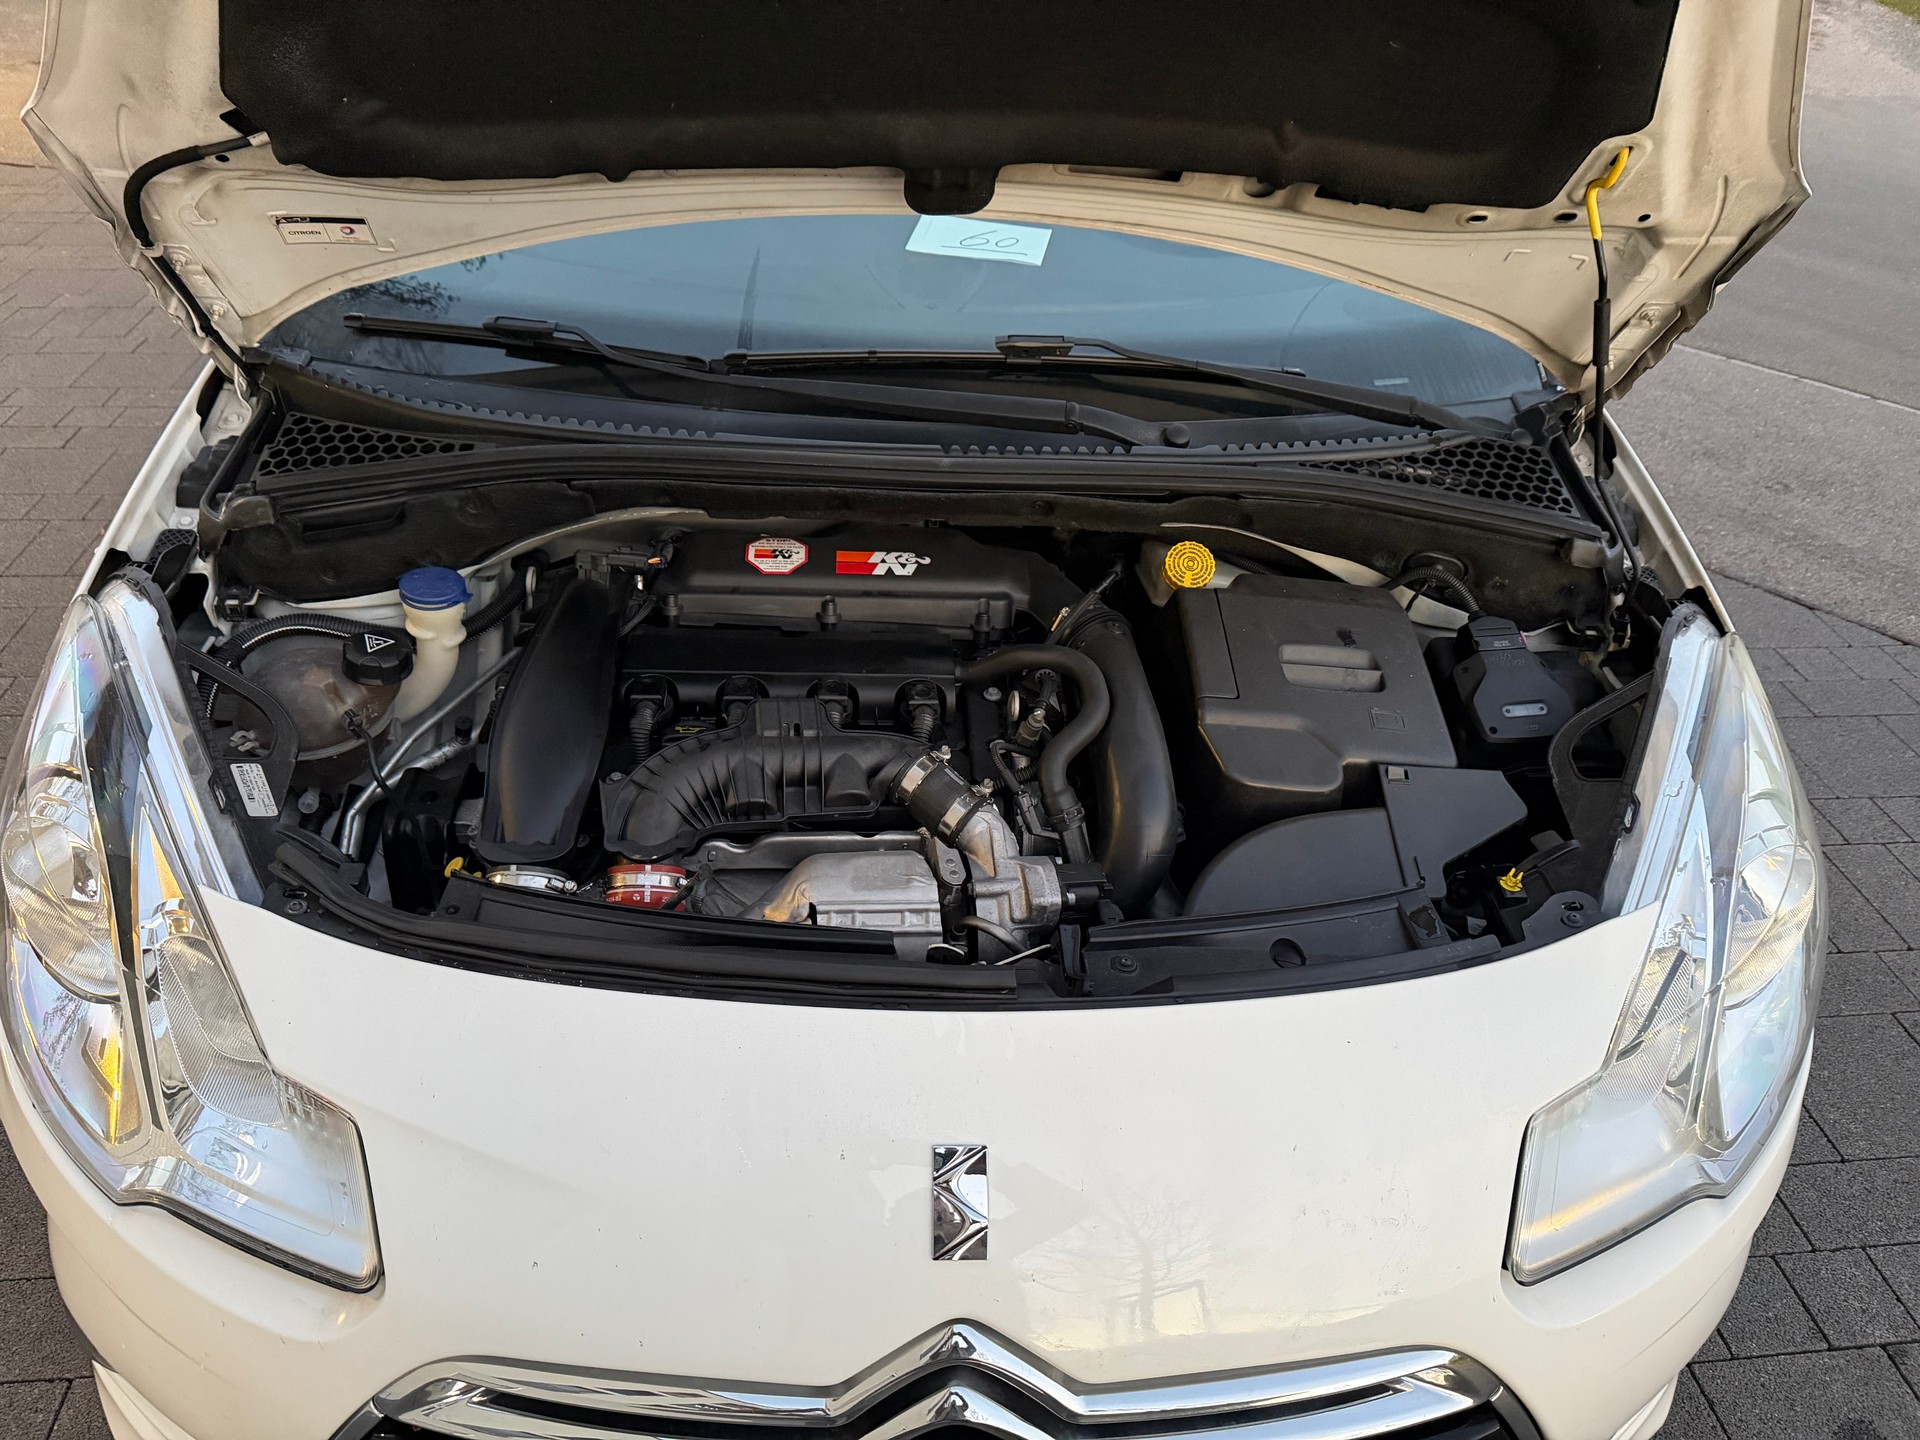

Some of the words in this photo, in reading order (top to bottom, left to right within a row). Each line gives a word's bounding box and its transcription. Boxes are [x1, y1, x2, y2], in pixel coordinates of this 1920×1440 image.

[960, 230, 1019, 248] 60
[771, 548, 800, 559] K&N
[867, 551, 931, 576] K&N
